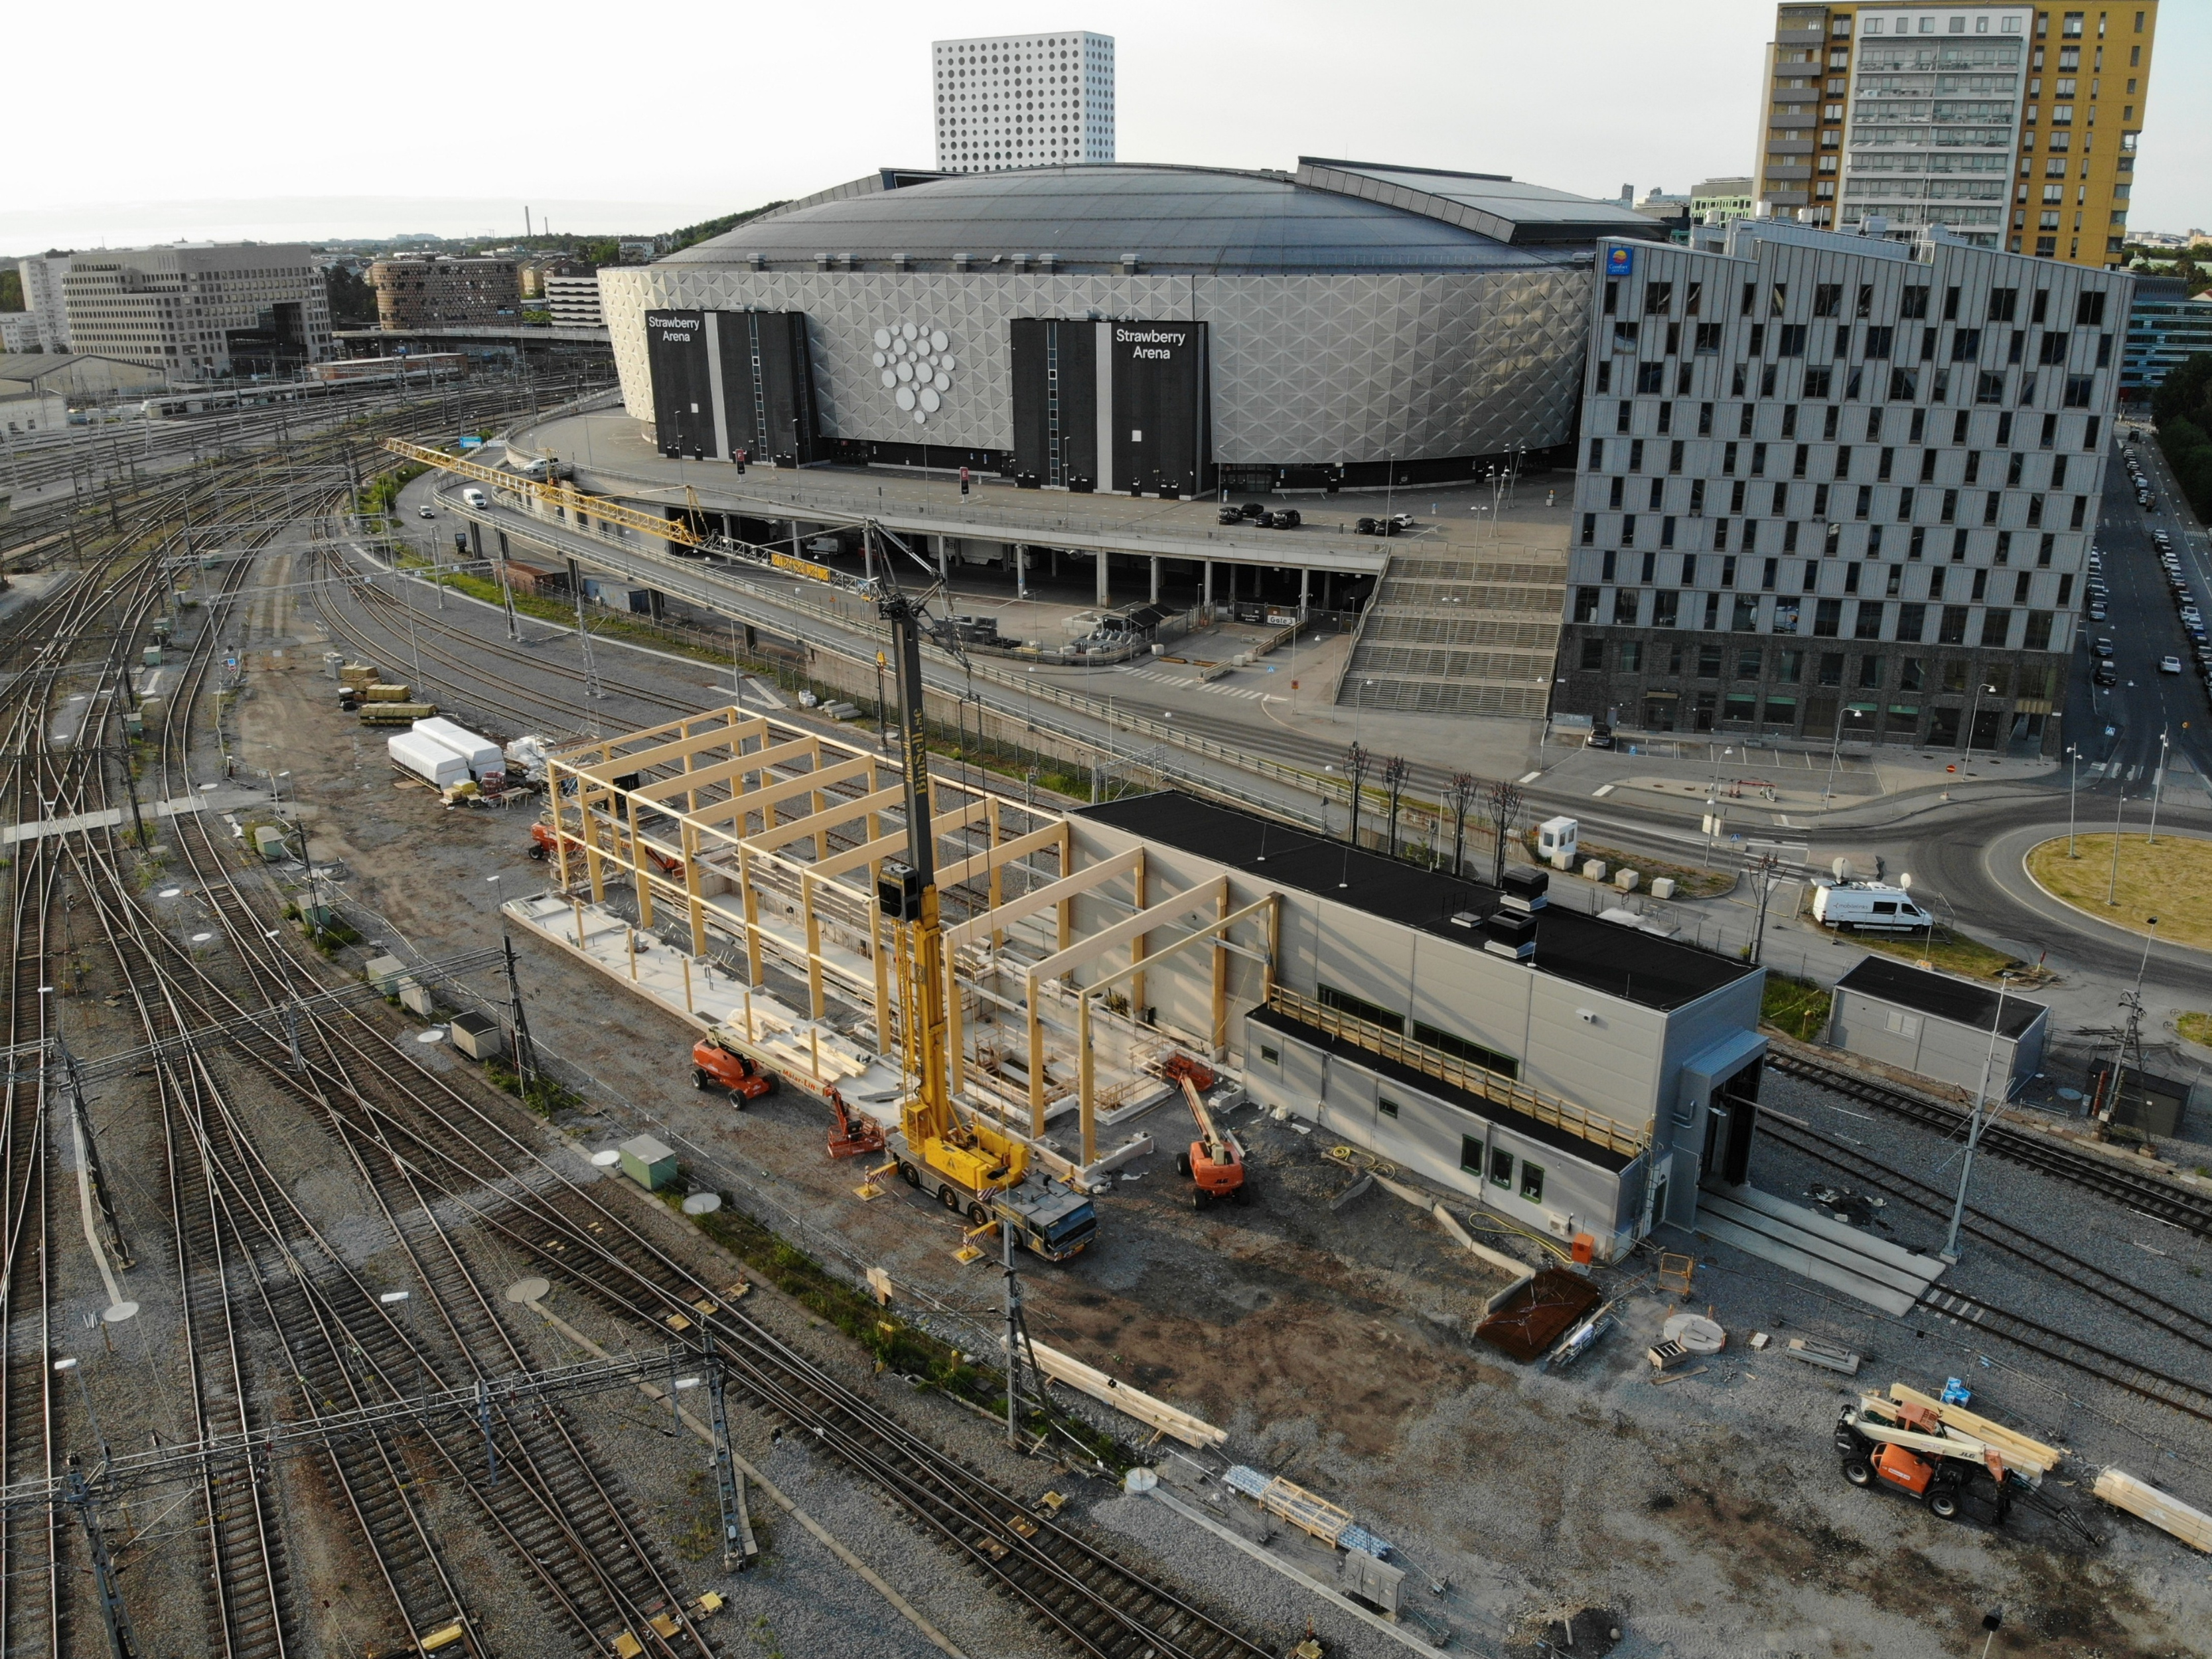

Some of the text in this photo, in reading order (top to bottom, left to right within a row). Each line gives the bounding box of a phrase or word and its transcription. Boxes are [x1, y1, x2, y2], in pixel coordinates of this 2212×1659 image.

[648, 316, 700, 331] Strawberry
[662, 330, 690, 342] Arena
[1116, 328, 1185, 346] Strawberry
[1133, 345, 1170, 359] Arena
[911, 707, 927, 794] BinSell.se
